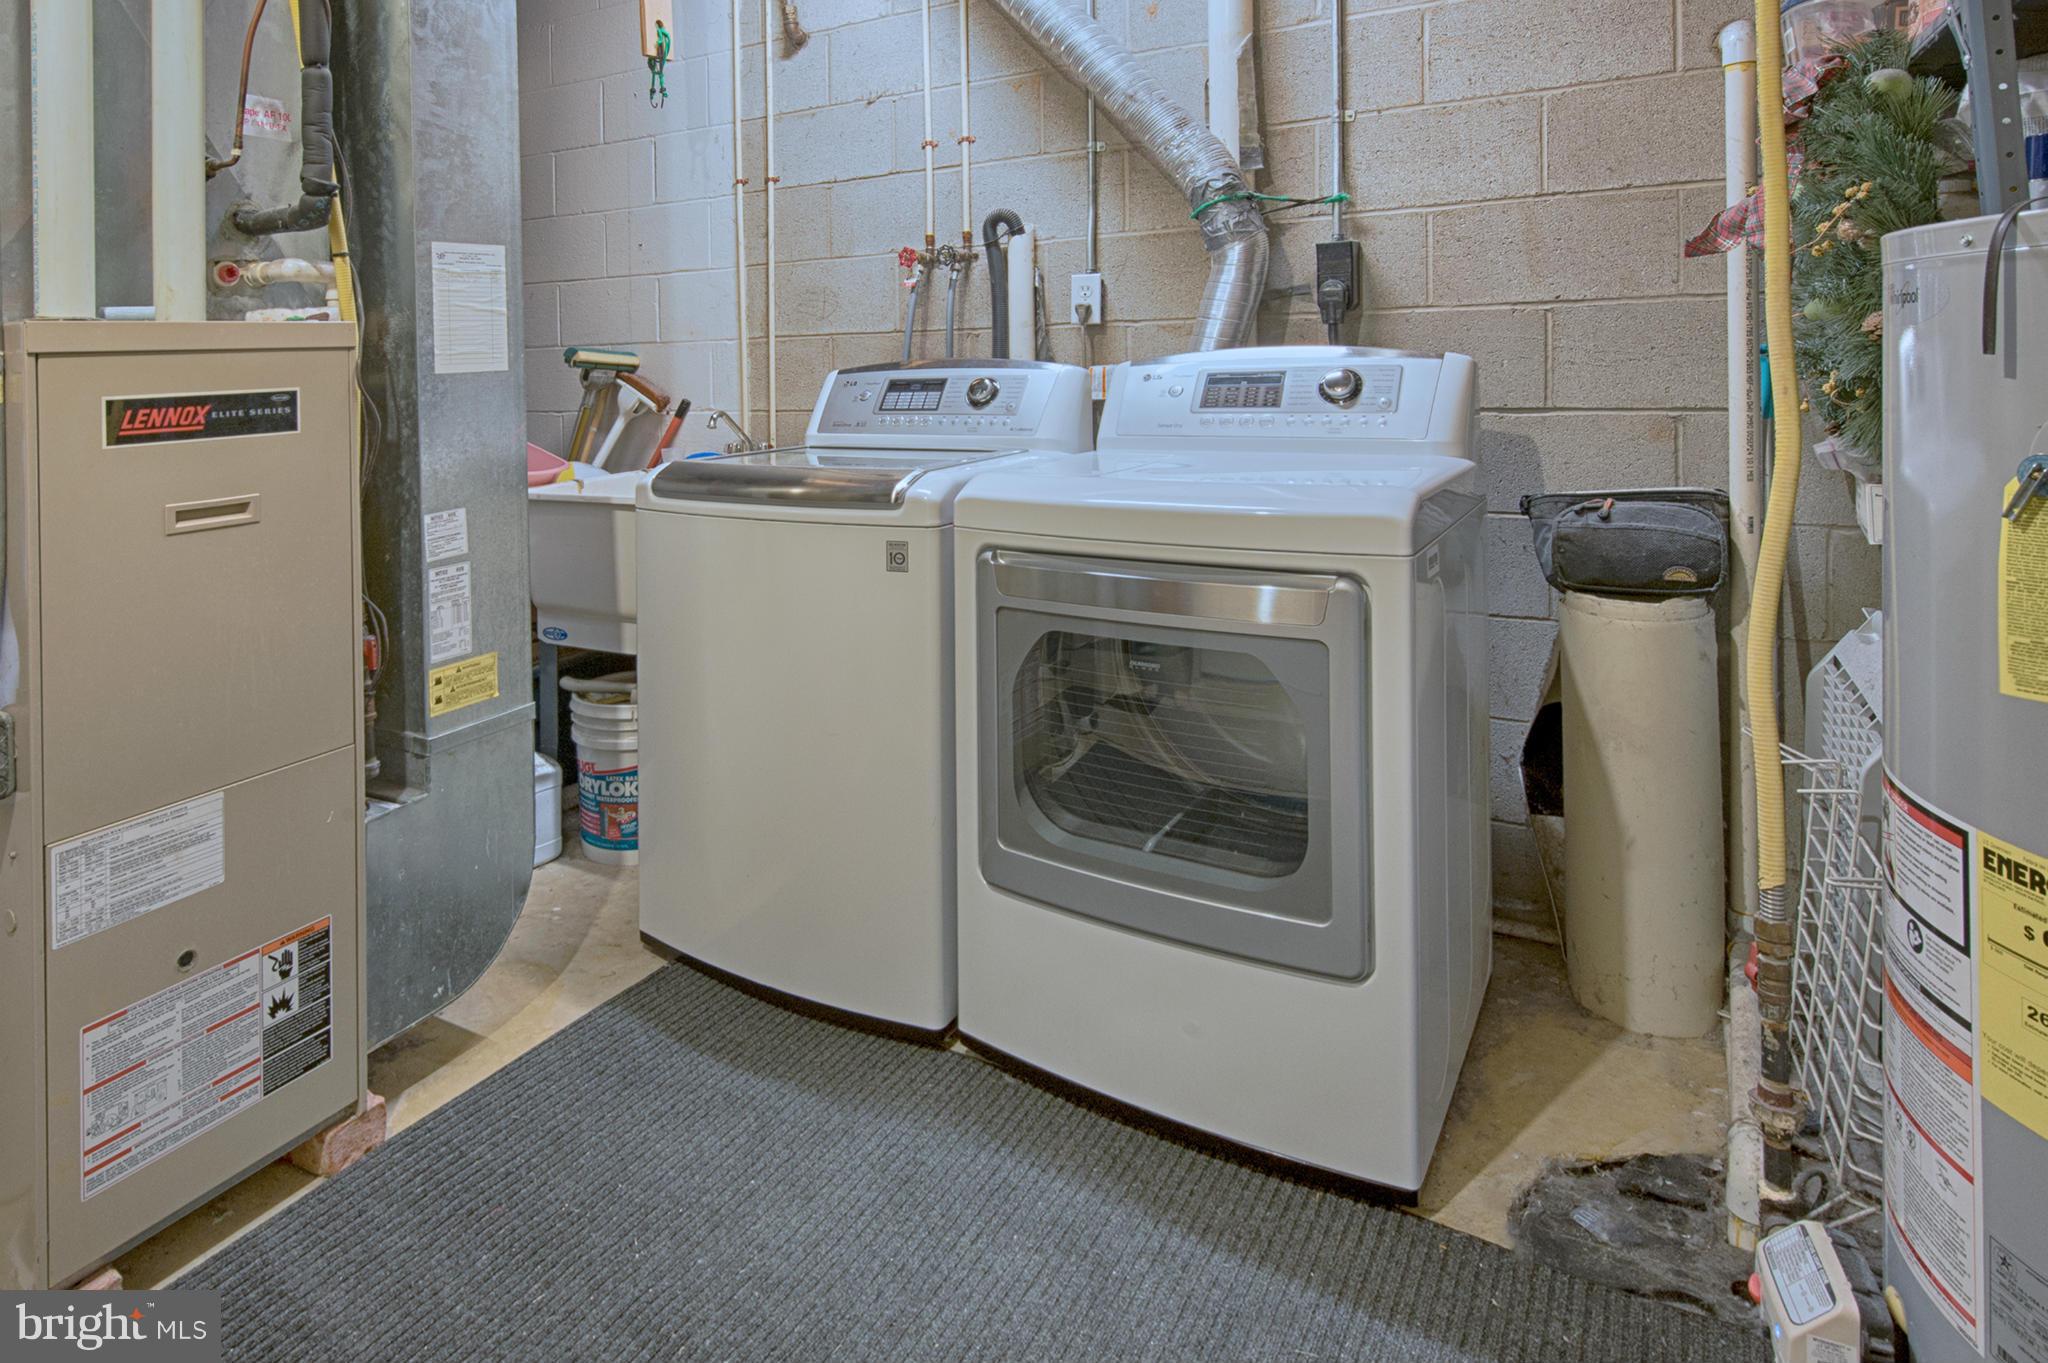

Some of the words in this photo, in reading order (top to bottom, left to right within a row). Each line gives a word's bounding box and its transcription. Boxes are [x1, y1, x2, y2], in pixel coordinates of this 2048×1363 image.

[121, 404, 212, 430] LENNOX
[211, 410, 244, 419] ELITE
[249, 407, 291, 416] SERIES
[579, 771, 639, 798] DRYLOK
[1983, 846, 2048, 897] ENER
